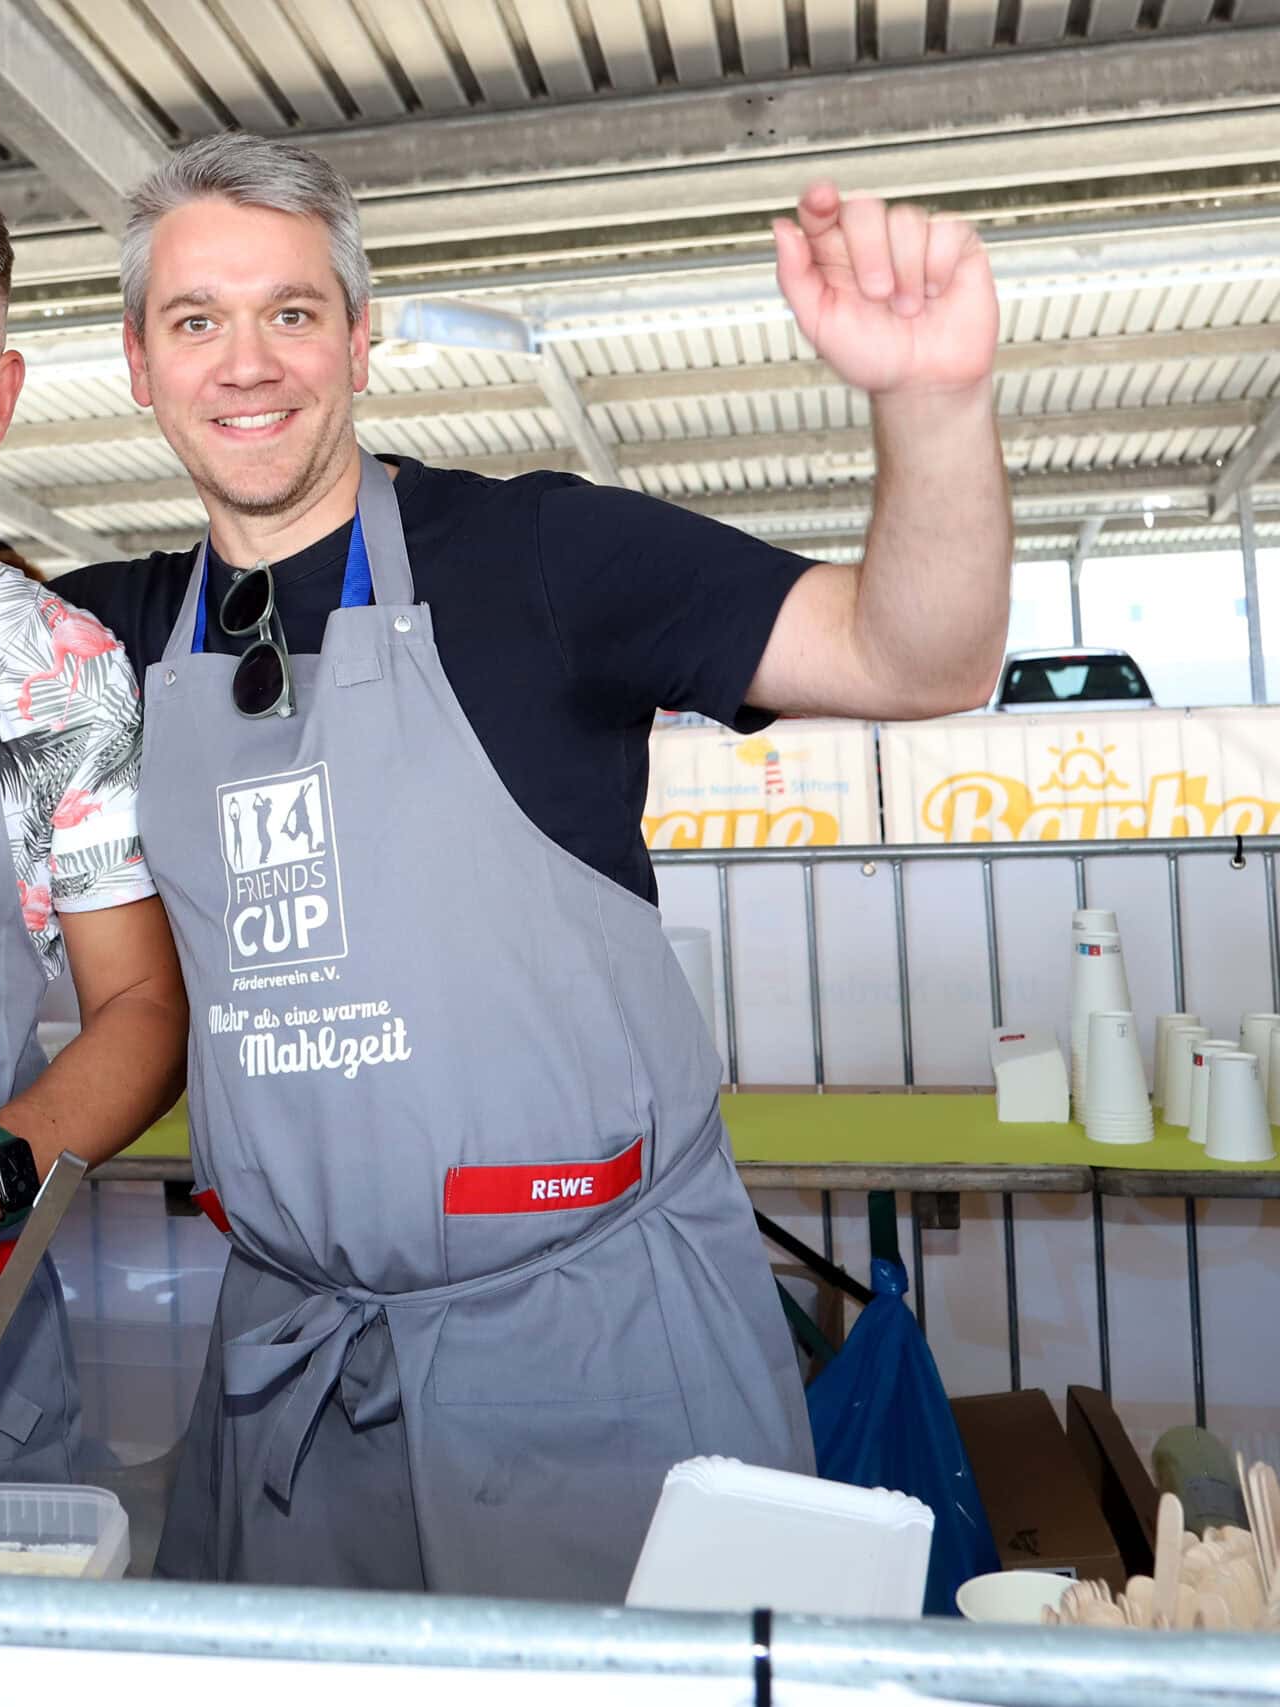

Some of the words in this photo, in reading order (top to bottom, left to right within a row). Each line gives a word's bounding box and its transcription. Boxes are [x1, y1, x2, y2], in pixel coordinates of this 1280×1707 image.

[236, 861, 327, 904] FRIENDS
[233, 894, 329, 957] CUP
[232, 970, 308, 991] Förderverein
[310, 966, 340, 982] e.V.
[209, 1003, 249, 1035] Mehr
[254, 1008, 280, 1030] als
[285, 1006, 320, 1027] eine
[322, 1000, 391, 1022] warme
[239, 1017, 412, 1080] Mahlzeit
[531, 1177, 594, 1200] REWE
